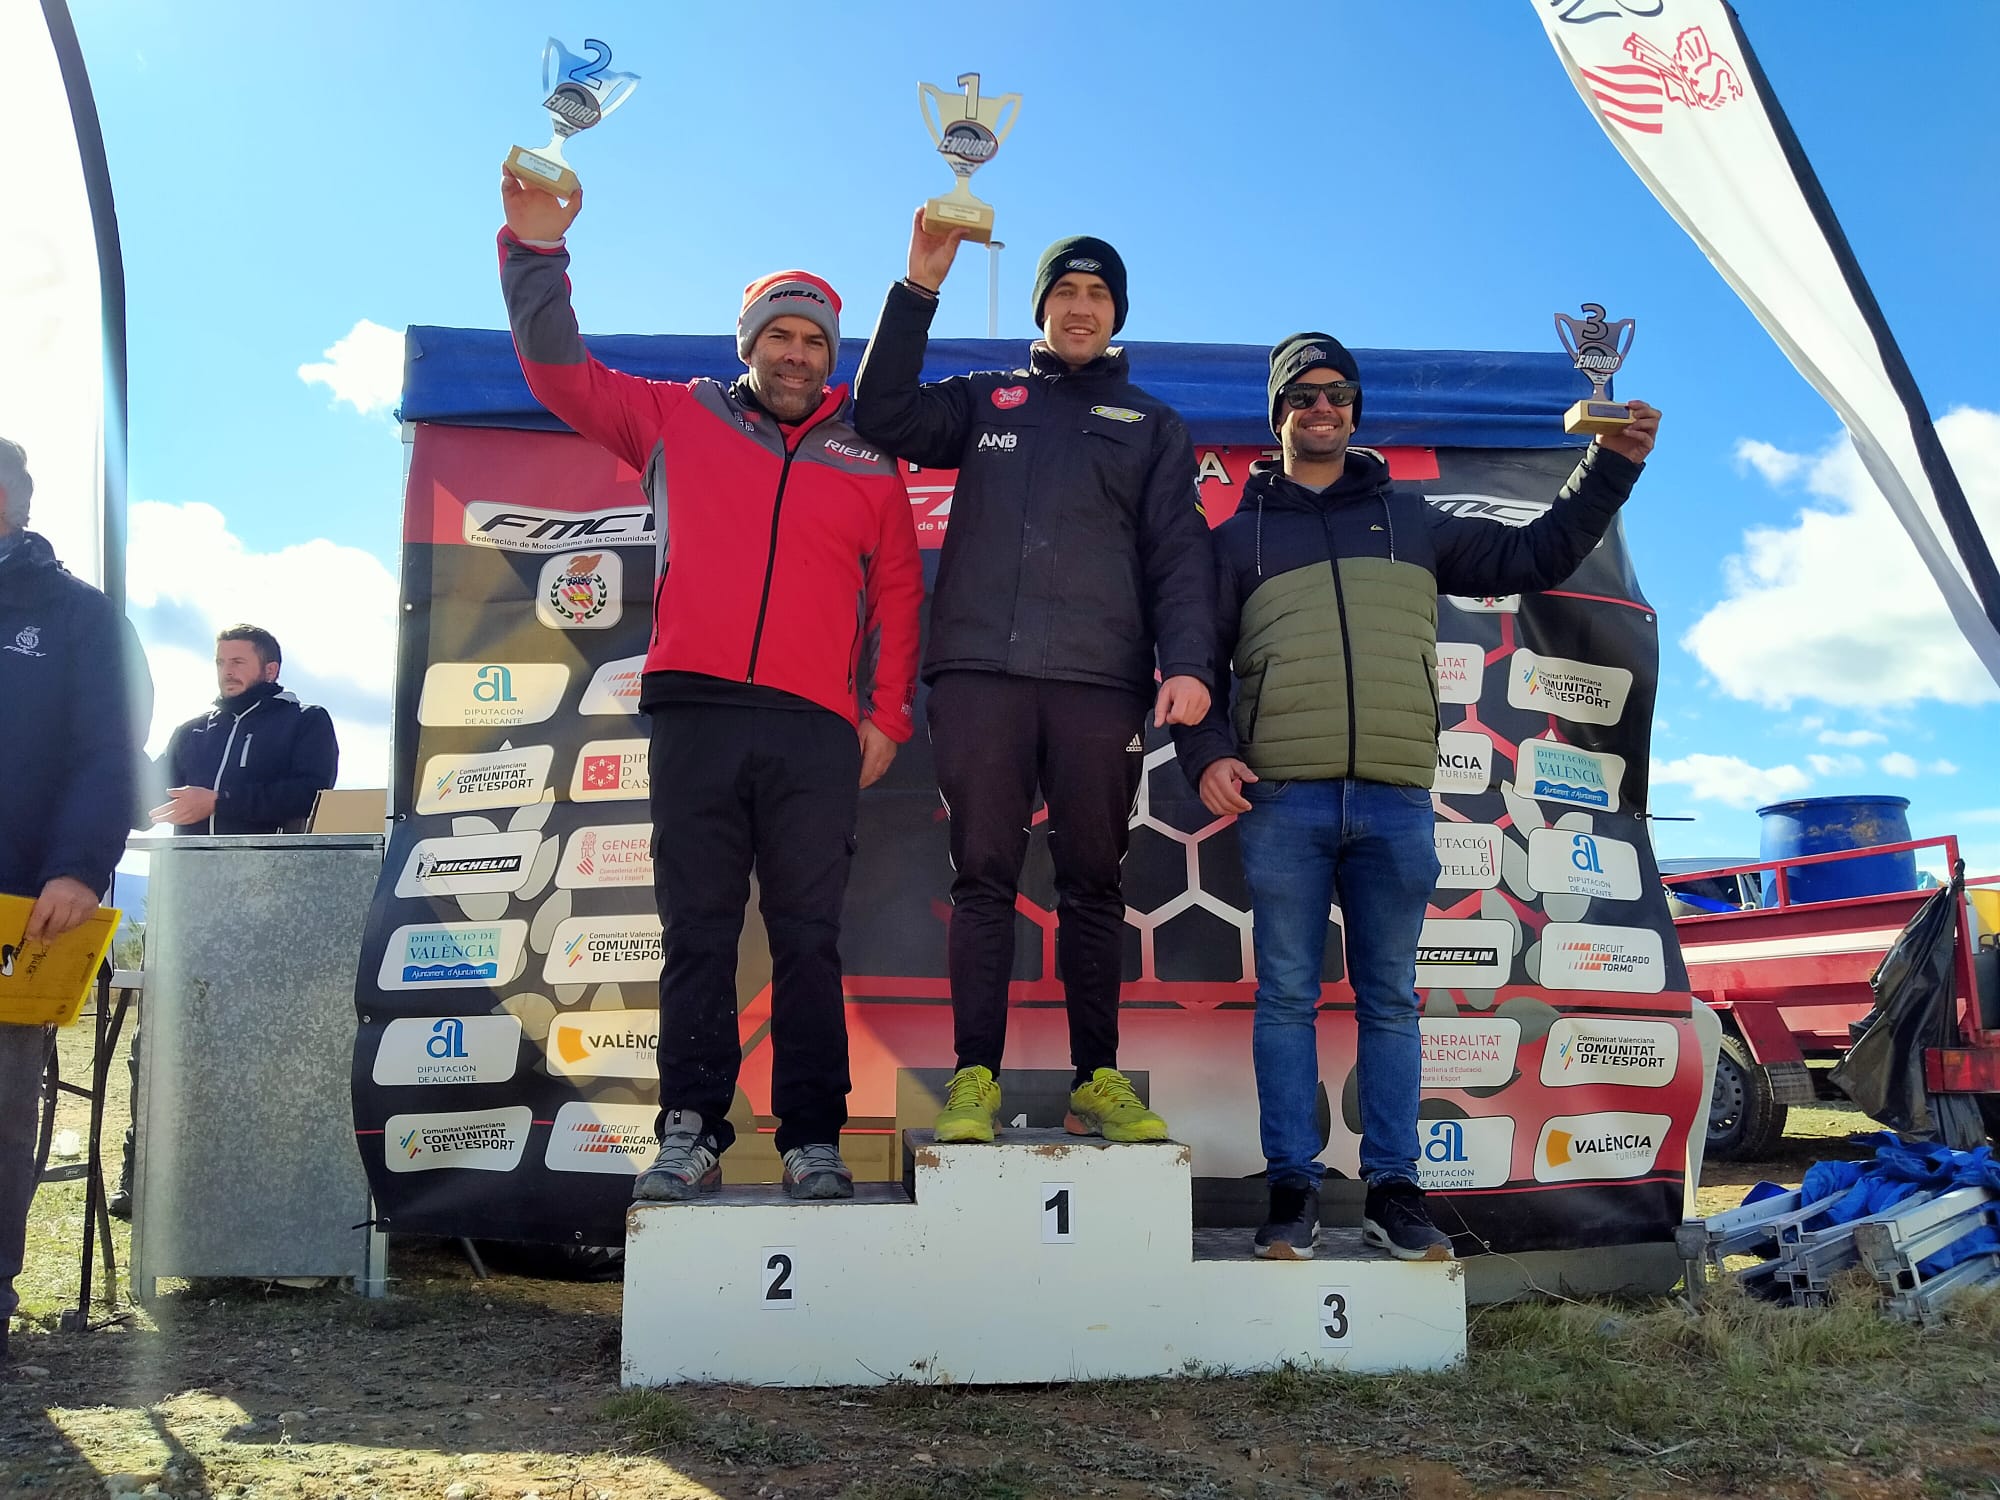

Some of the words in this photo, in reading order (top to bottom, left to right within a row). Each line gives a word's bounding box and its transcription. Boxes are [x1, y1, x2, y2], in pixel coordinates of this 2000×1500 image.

[569, 38, 612, 90] 2
[957, 72, 980, 120] 1
[544, 94, 599, 124] ENDURO
[940, 136, 996, 157] ENDURO
[769, 290, 825, 303] RIEJU
[1580, 303, 1608, 340] 3
[1577, 354, 1620, 369] ENDURO
[824, 440, 880, 462] RIEJU
[917, 521, 934, 531] de
[471, 534, 518, 548] Federación
[519, 540, 530, 549] de
[531, 539, 582, 550] Motociclismo
[584, 538, 594, 546] de
[1539, 675, 1602, 697] COMUNITAT
[1564, 674, 1602, 687] Valenciana
[1544, 686, 1554, 697] DE
[1554, 691, 1611, 709] L'ESPORT
[459, 766, 491, 775] Comunitat
[493, 762, 527, 772] Valenciana
[1440, 770, 1483, 780] TURISME
[457, 769, 526, 785] COMUNITAT
[459, 783, 475, 794] DE
[477, 778, 534, 793] L'ESPORT
[436, 857, 519, 873] MICHELIN
[1581, 887, 1613, 897] ALICANTE
[480, 932, 495, 940] DE
[589, 931, 628, 939] Comunitat
[410, 943, 495, 959] VALÈNCIA
[1592, 943, 1625, 953] CIRCUIT
[593, 952, 611, 962] DE
[1612, 954, 1650, 965] RICARDO
[411, 970, 445, 979] Ajuntament
[1603, 963, 1634, 973] TORMO
[1578, 1034, 1617, 1043] Comunitat
[1618, 1036, 1655, 1044] Valenciana
[1576, 1042, 1655, 1056] COMUNITAT
[1581, 1054, 1598, 1064] DE
[1602, 1055, 1665, 1068] L'ESPORT
[417, 1064, 477, 1073] DIPUTACIÓN
[432, 1075, 477, 1083] ALICANTE
[421, 1125, 462, 1135] Comunitat
[463, 1121, 506, 1132] Valenciana
[601, 1124, 640, 1134] CIRCUIT
[423, 1129, 506, 1145] COMUNITAT
[1575, 1134, 1652, 1154] VALÈNCIA
[432, 1142, 452, 1153] DE
[454, 1139, 515, 1153] L'ESPORT
[610, 1145, 646, 1154] TORMO
[1615, 1150, 1650, 1161] TURISME
[1429, 1180, 1474, 1188] ALICANTE
[1045, 1190, 1070, 1235] 1
[765, 1254, 793, 1300] 2
[1323, 1293, 1349, 1339] 3
